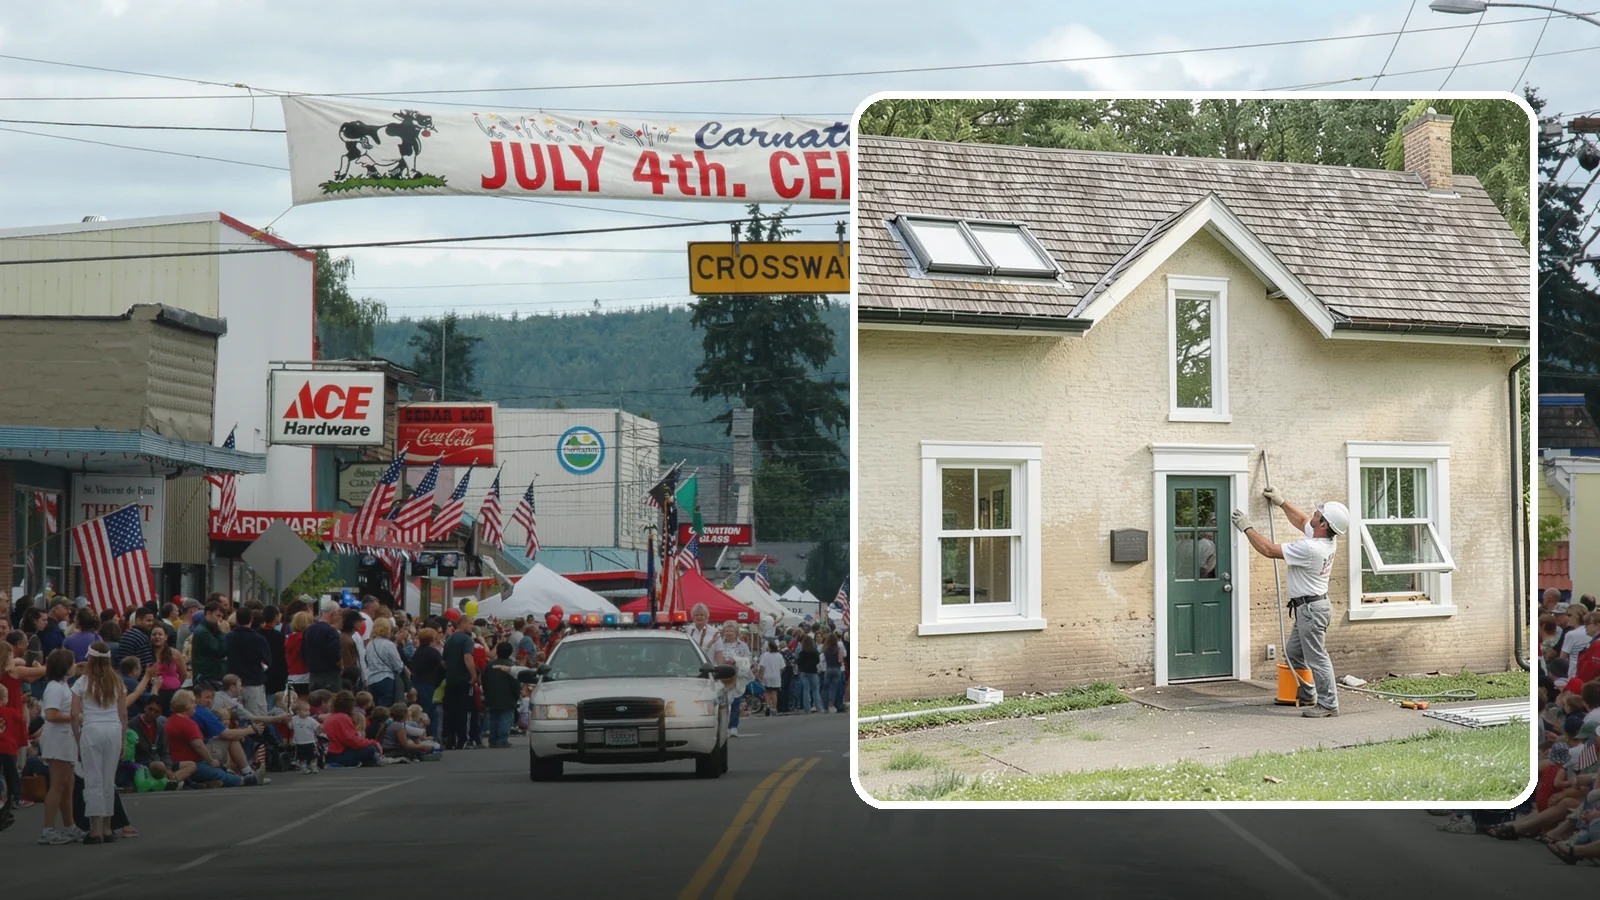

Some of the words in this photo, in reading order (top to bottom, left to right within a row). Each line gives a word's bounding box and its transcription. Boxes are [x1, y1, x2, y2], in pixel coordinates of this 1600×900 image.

[695, 121, 850, 149] Carnat
[481, 141, 605, 192] JULY
[632, 149, 747, 198] 4th.
[697, 254, 850, 280] CROSSWA
[283, 380, 373, 420] ACE
[406, 409, 452, 421] CEDAR
[461, 409, 485, 421] LOG
[283, 421, 371, 436] Hardware
[95, 485, 124, 495] Vincent
[126, 486, 135, 494] de
[137, 486, 155, 495] Paul
[212, 516, 330, 536] HARDARE
[688, 527, 741, 535] CRNATION
[699, 535, 730, 543] GLASS
